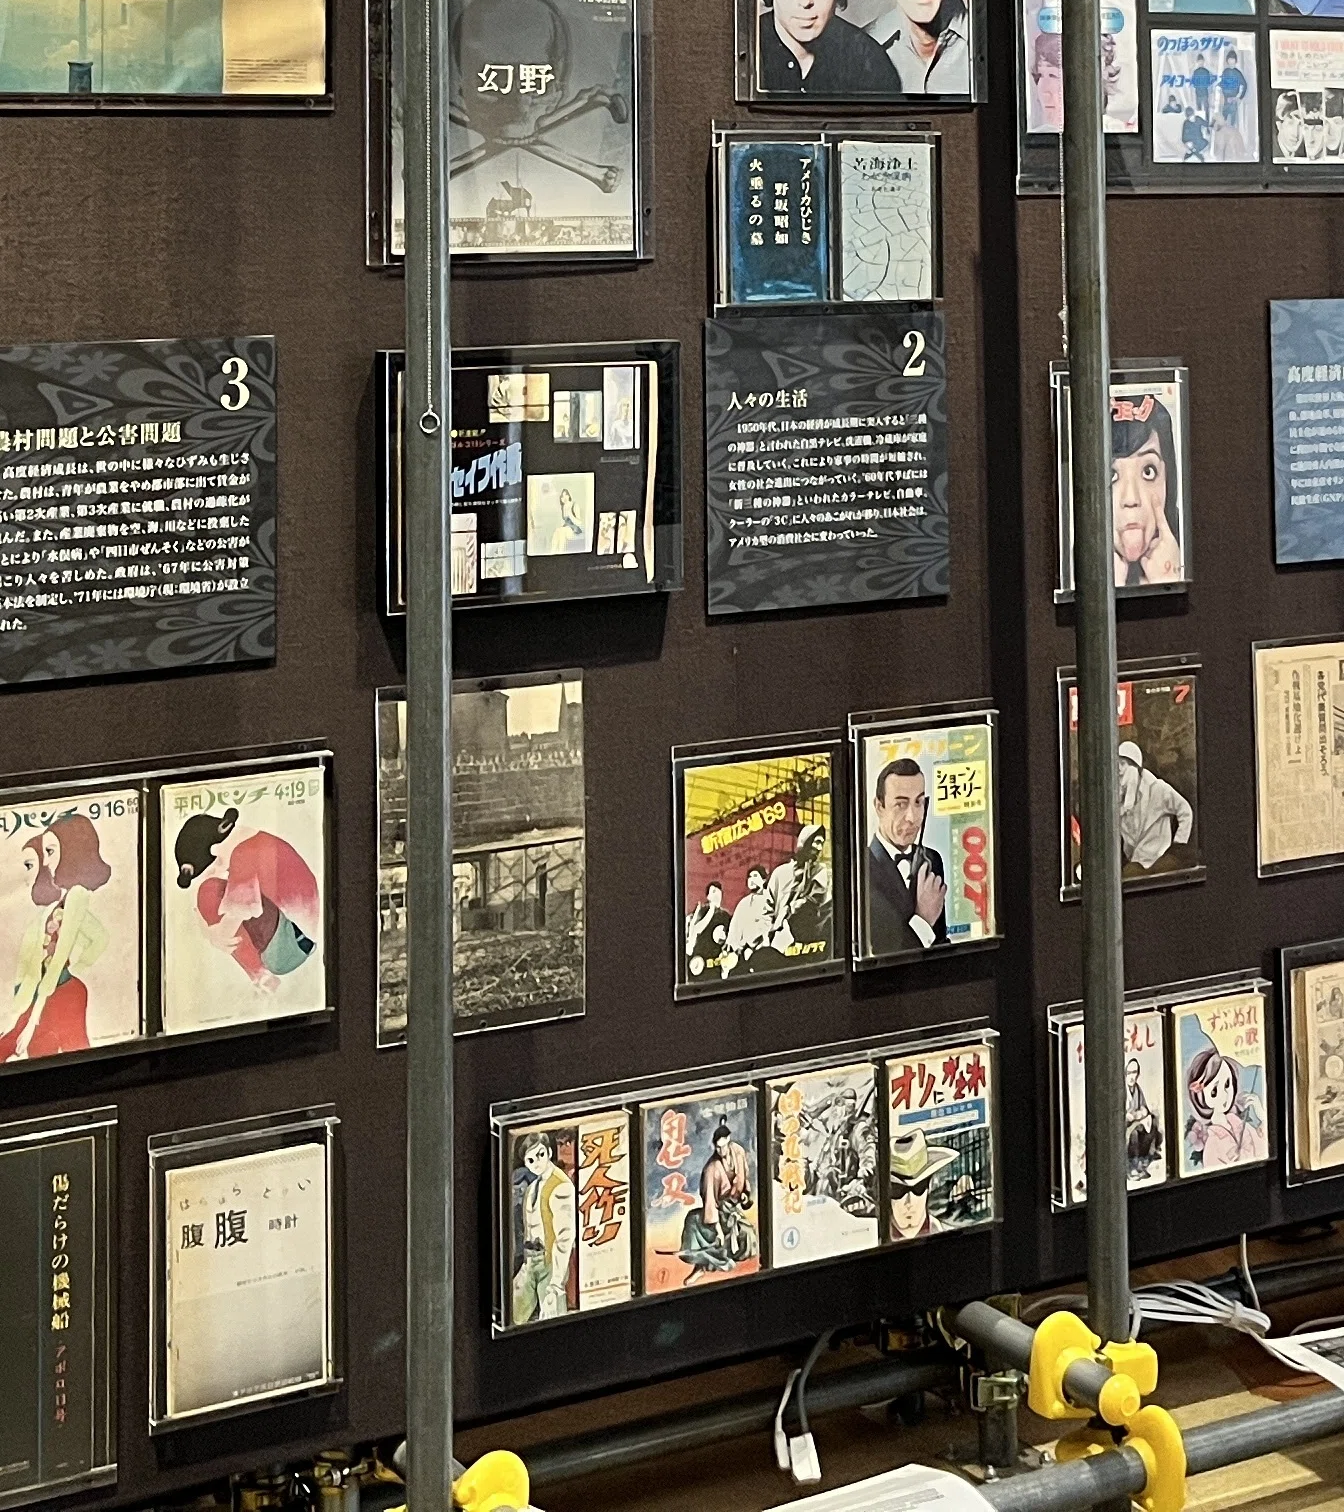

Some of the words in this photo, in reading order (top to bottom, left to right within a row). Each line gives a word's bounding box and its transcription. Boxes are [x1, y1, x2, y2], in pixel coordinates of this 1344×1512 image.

[1157, 35, 1231, 53] のっぽのサリー
[475, 61, 555, 96] 幻野
[747, 157, 764, 247] 火垂るの墓
[773, 180, 790, 247] 野坂昭如
[798, 156, 814, 246] アメリカひじき
[902, 330, 926, 377] 2
[220, 356, 250, 411] 3
[727, 389, 807, 411] 人々の生活
[936, 765, 977, 785] ショーン
[936, 782, 983, 801] コネリー
[173, 785, 270, 813] 平凡パンチ
[961, 825, 991, 936] 007
[180, 1208, 249, 1251] 腹腹
